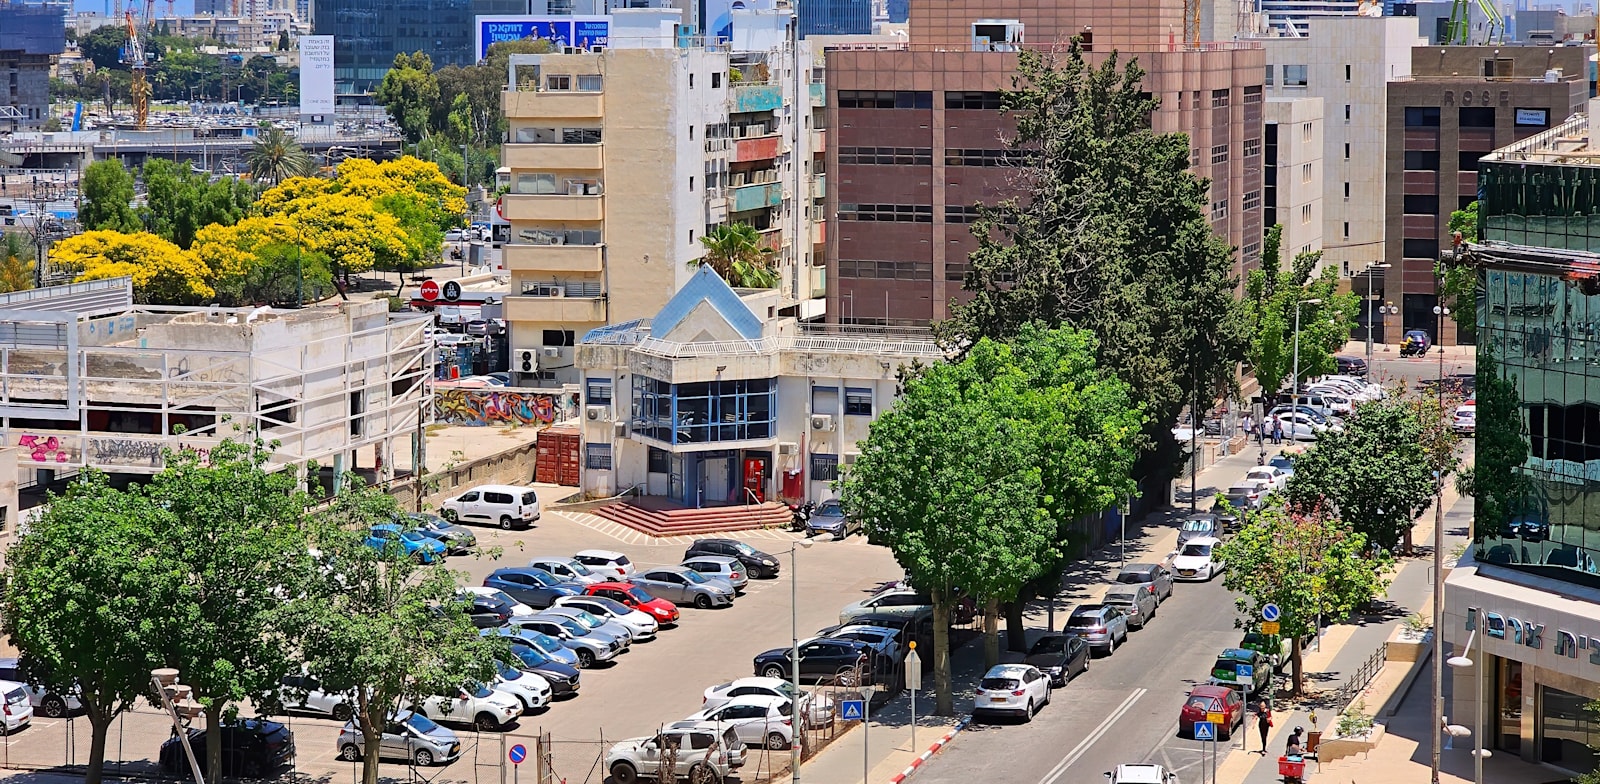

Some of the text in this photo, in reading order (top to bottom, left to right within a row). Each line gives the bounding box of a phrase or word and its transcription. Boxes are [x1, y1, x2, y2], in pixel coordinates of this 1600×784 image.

[489, 24, 523, 33] דווקא כן
[1444, 90, 1508, 107] ROSE
